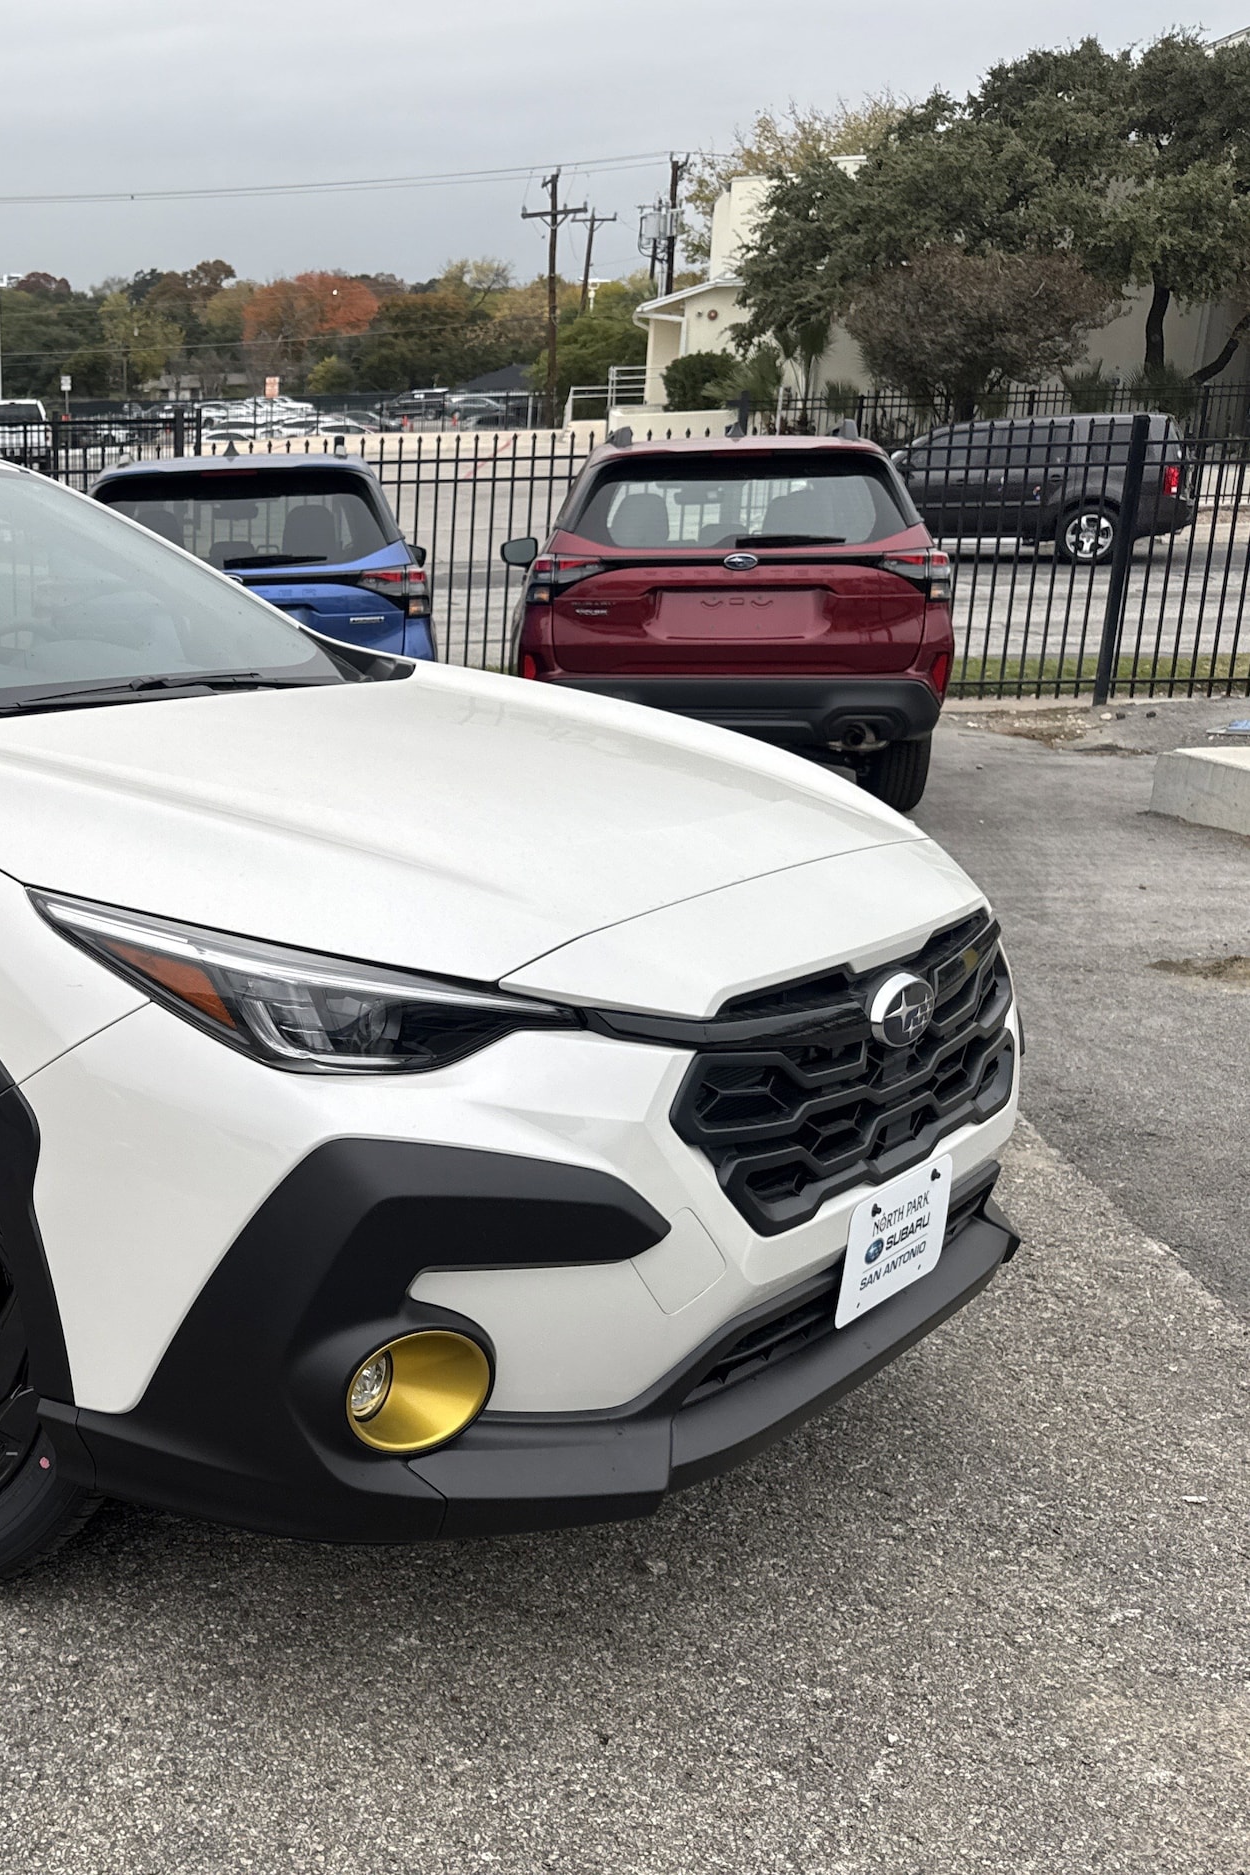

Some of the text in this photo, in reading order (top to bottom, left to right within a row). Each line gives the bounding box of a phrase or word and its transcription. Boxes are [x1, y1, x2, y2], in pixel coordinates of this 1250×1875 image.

[871, 1190, 930, 1238] NORTH PARK
[885, 1212, 931, 1250] SUBARU
[859, 1241, 927, 1291] SAN ANTONIO
